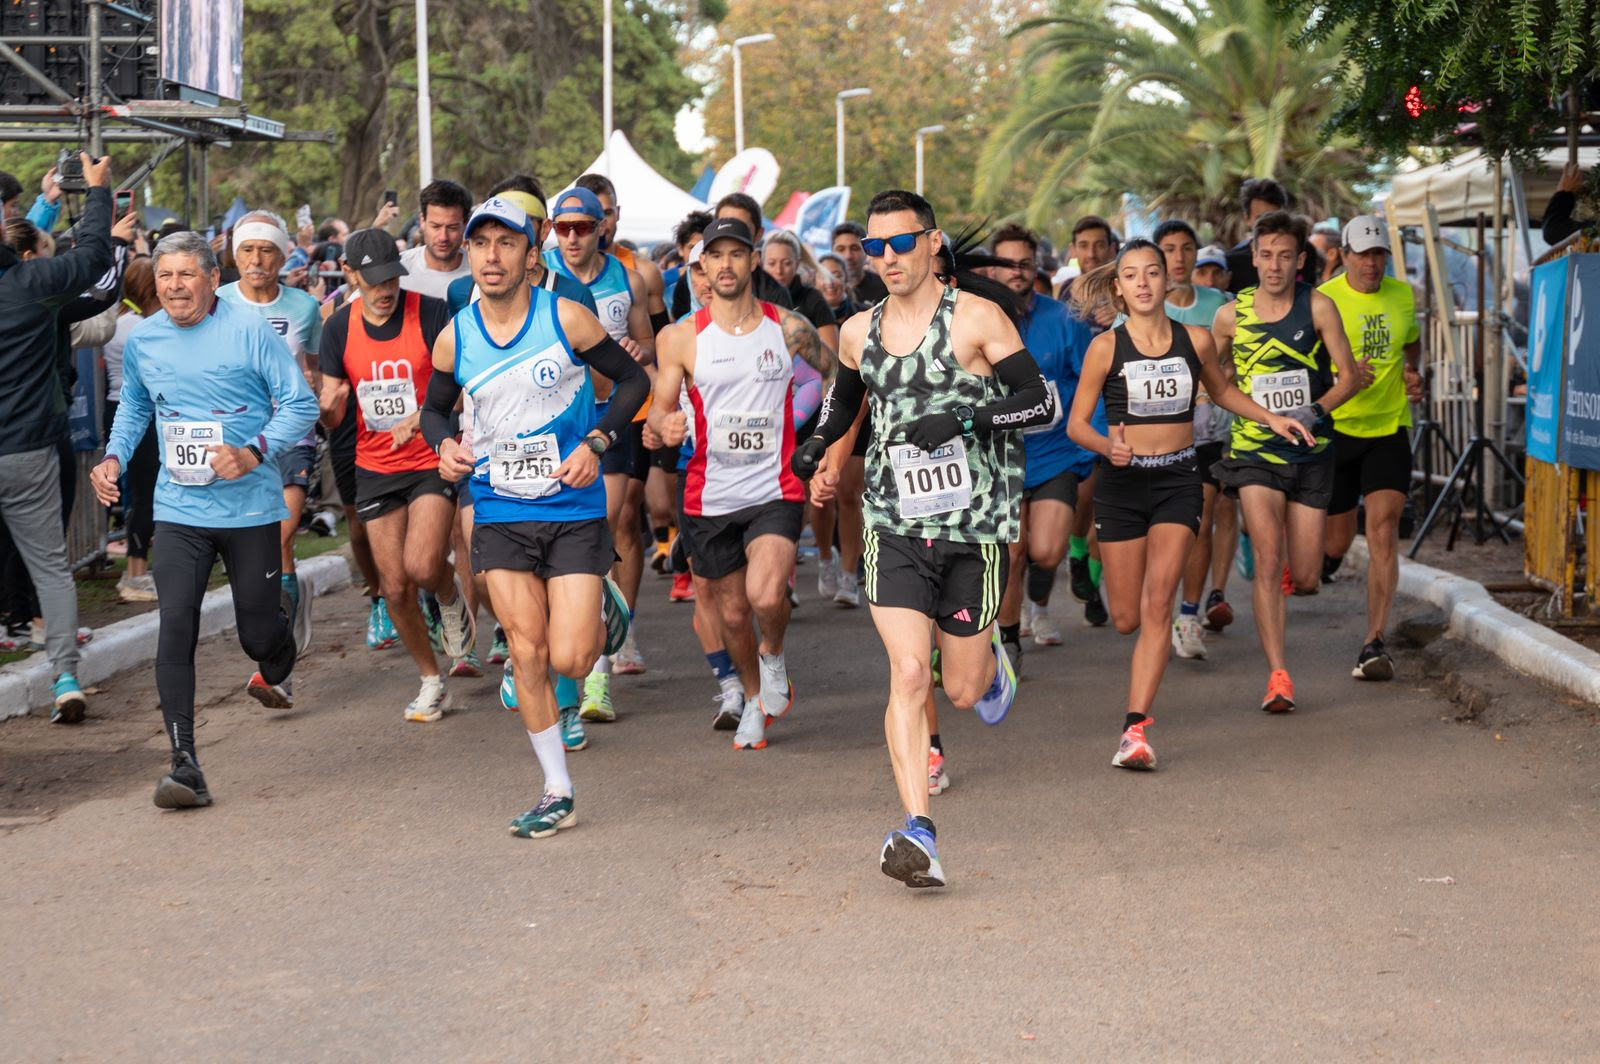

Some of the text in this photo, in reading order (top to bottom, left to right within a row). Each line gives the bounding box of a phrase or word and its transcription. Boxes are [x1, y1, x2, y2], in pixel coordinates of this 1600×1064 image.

[1363, 313, 1387, 329] WE
[1363, 330, 1391, 345] RUN
[540, 366, 556, 381] ft
[1160, 363, 1181, 373] 10K
[1143, 378, 1178, 400] 143
[1262, 388, 1305, 409] 1009
[374, 397, 406, 416] 639
[992, 403, 1048, 425] balance
[191, 427, 213, 438] 10K
[728, 431, 765, 450] 963
[176, 444, 209, 466] 967
[523, 440, 548, 454] 10K
[502, 457, 554, 481] 1256
[904, 462, 962, 495] 1010
